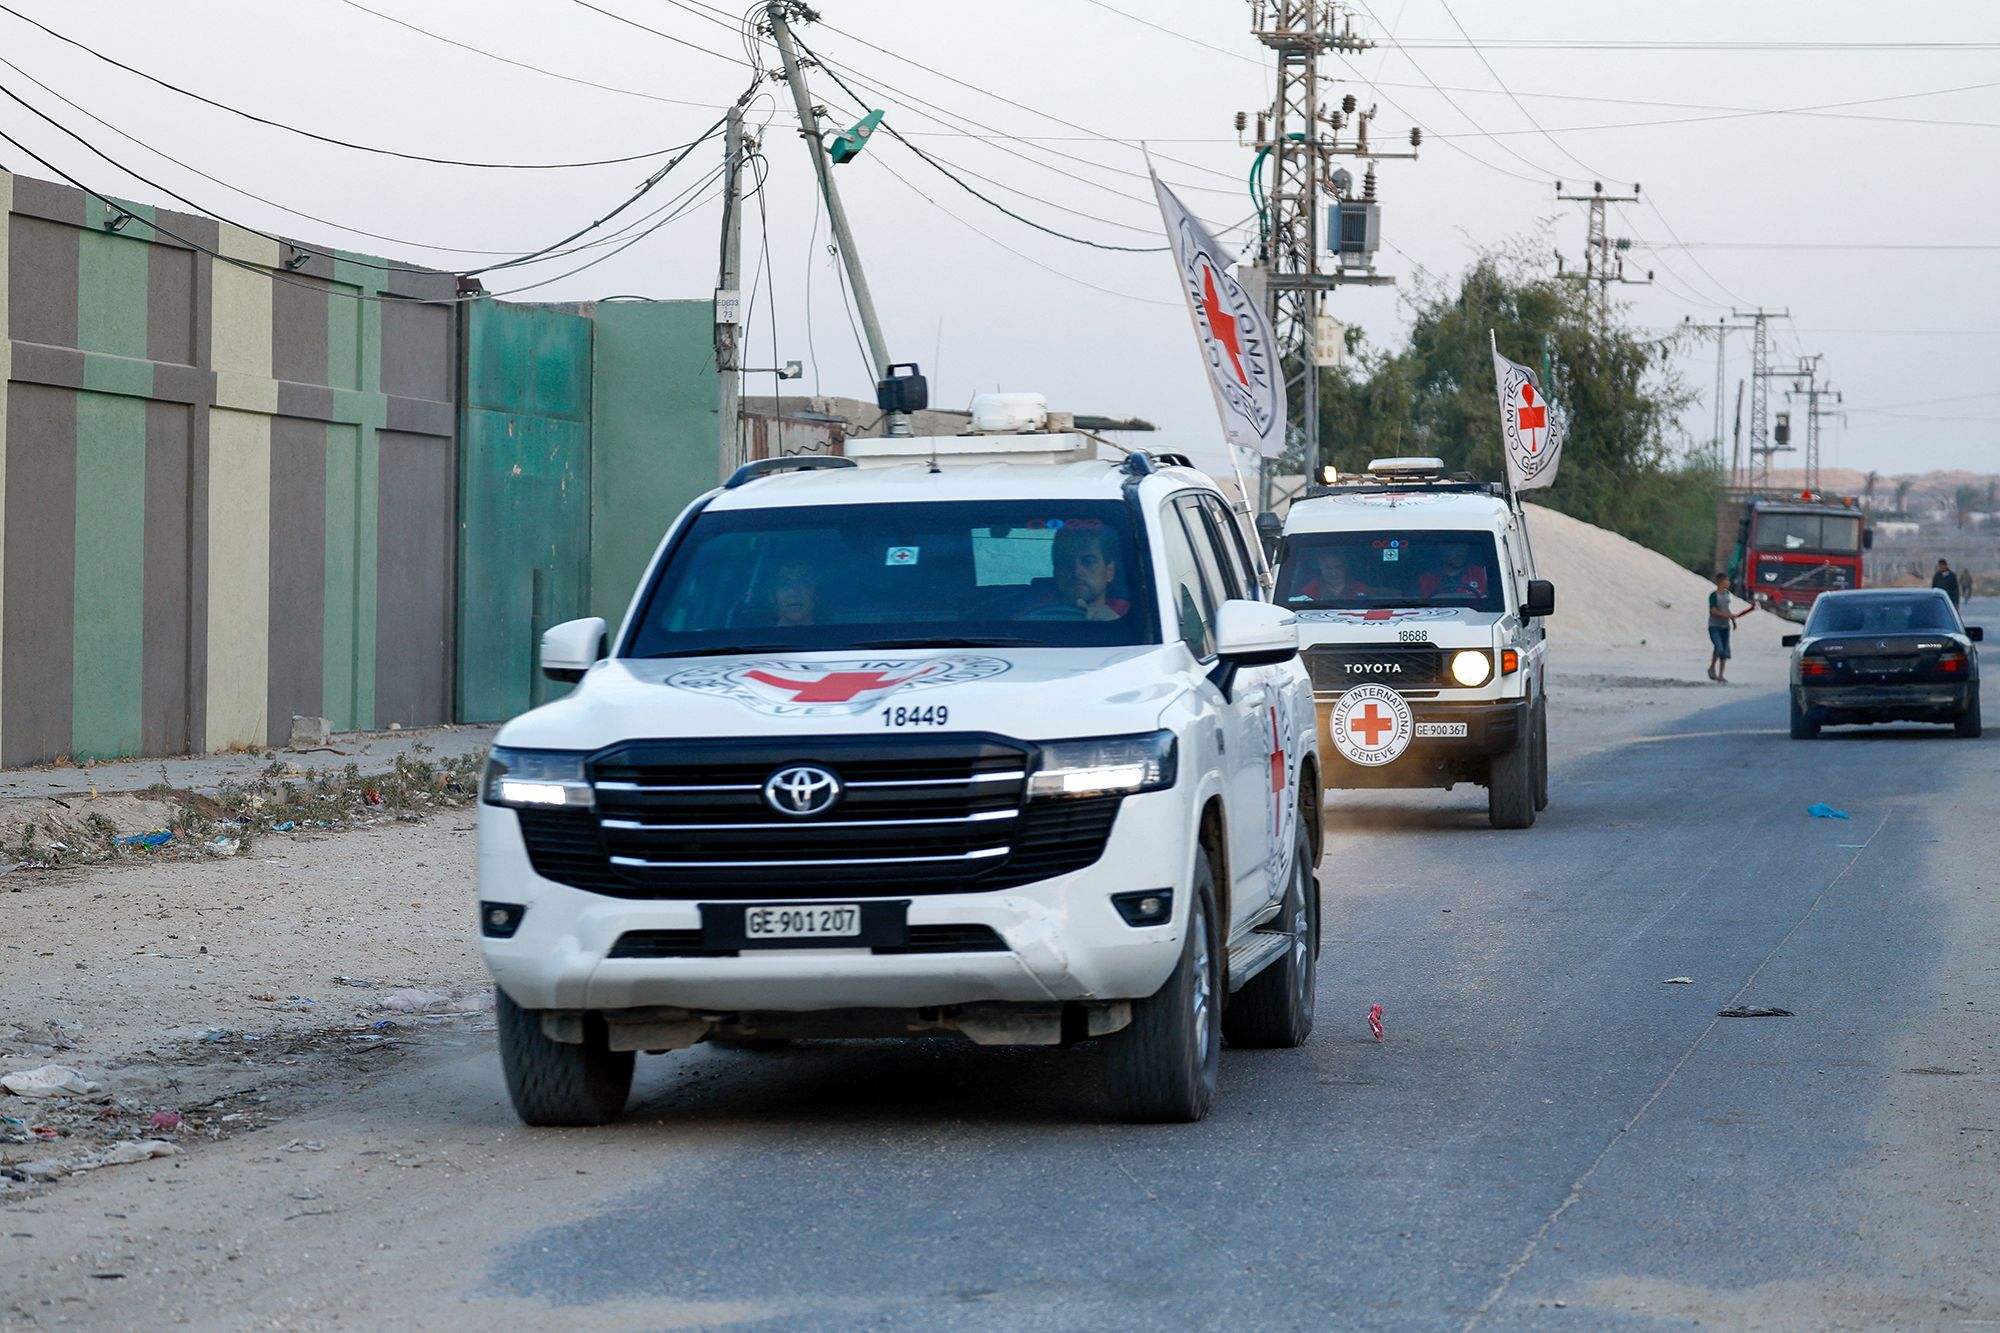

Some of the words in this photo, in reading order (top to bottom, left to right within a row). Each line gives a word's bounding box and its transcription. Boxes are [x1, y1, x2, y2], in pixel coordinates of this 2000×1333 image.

[1398, 630, 1428, 641] 18688
[1344, 664, 1402, 673] TOYOTA
[881, 706, 949, 727] 18449
[1334, 700, 1350, 744] COMITE
[1350, 687, 1409, 741] INTERNATIONAL
[1350, 746, 1397, 762] GENEVE
